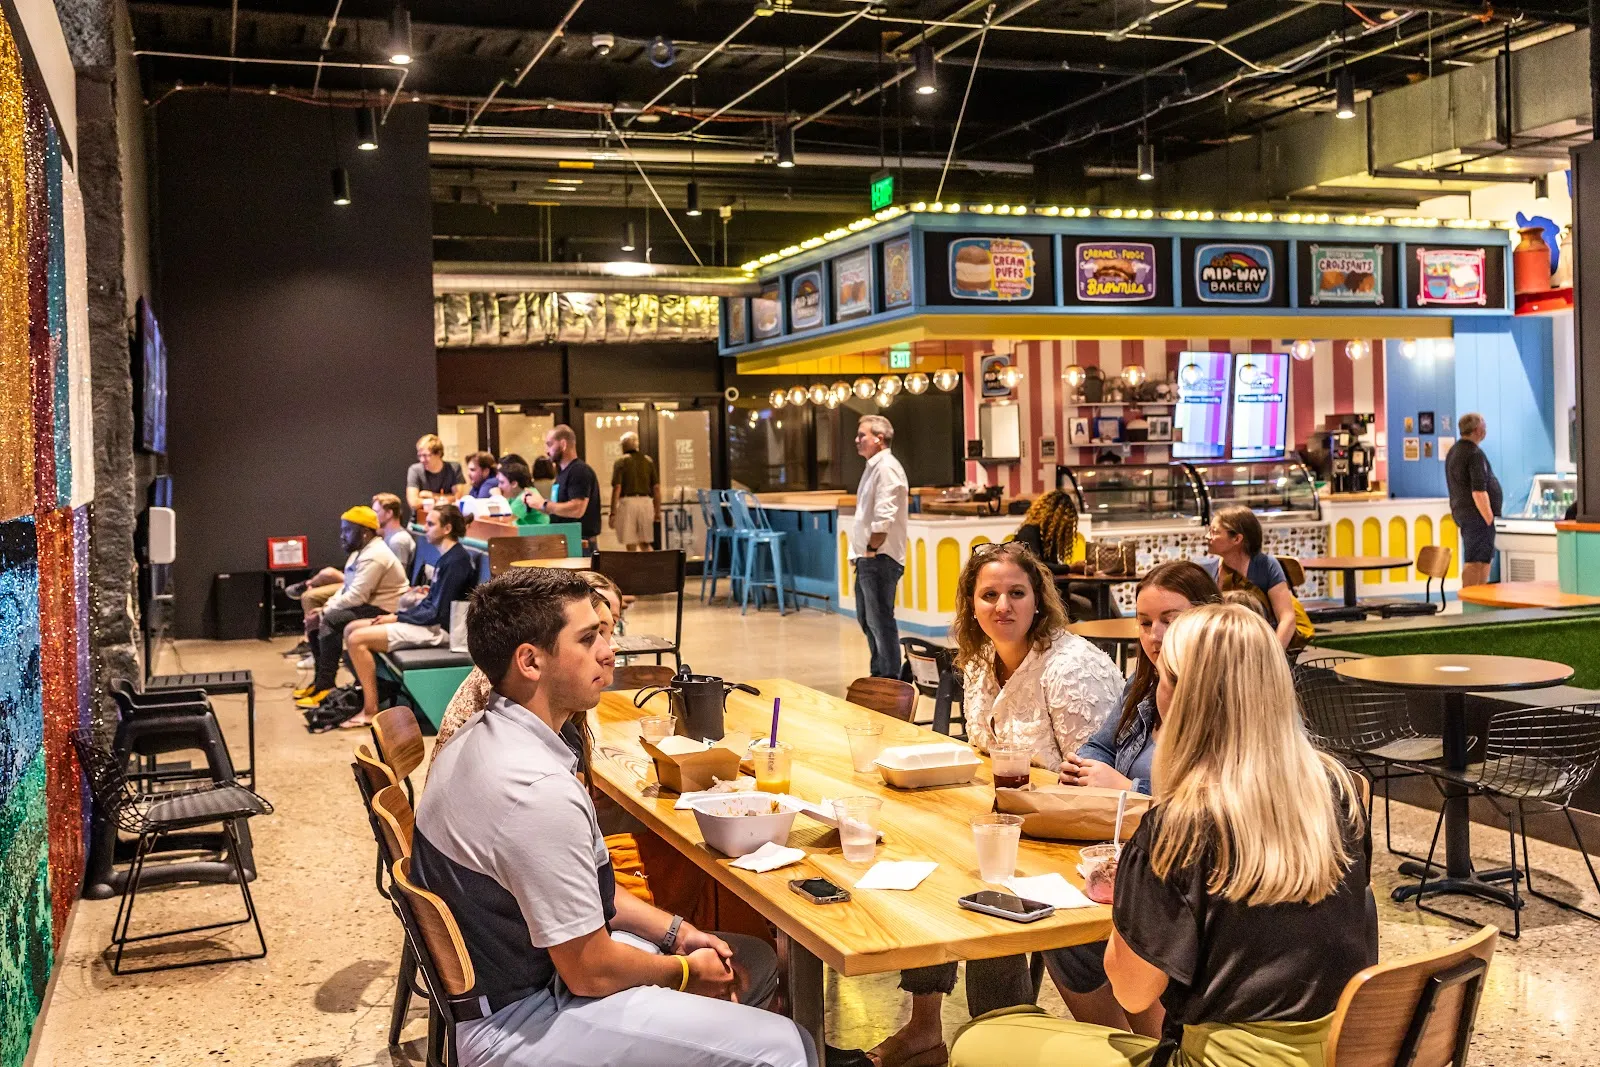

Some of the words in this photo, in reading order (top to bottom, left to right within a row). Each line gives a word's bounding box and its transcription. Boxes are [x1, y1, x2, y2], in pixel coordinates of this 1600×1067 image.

[993, 255, 1025, 267] CREAM
[996, 268, 1024, 278] PUFFS
[1203, 267, 1267, 282] MID-WAY
[1086, 277, 1146, 296] Brownies
[1210, 281, 1260, 292] BAKERY
[1076, 422, 1085, 434] A
